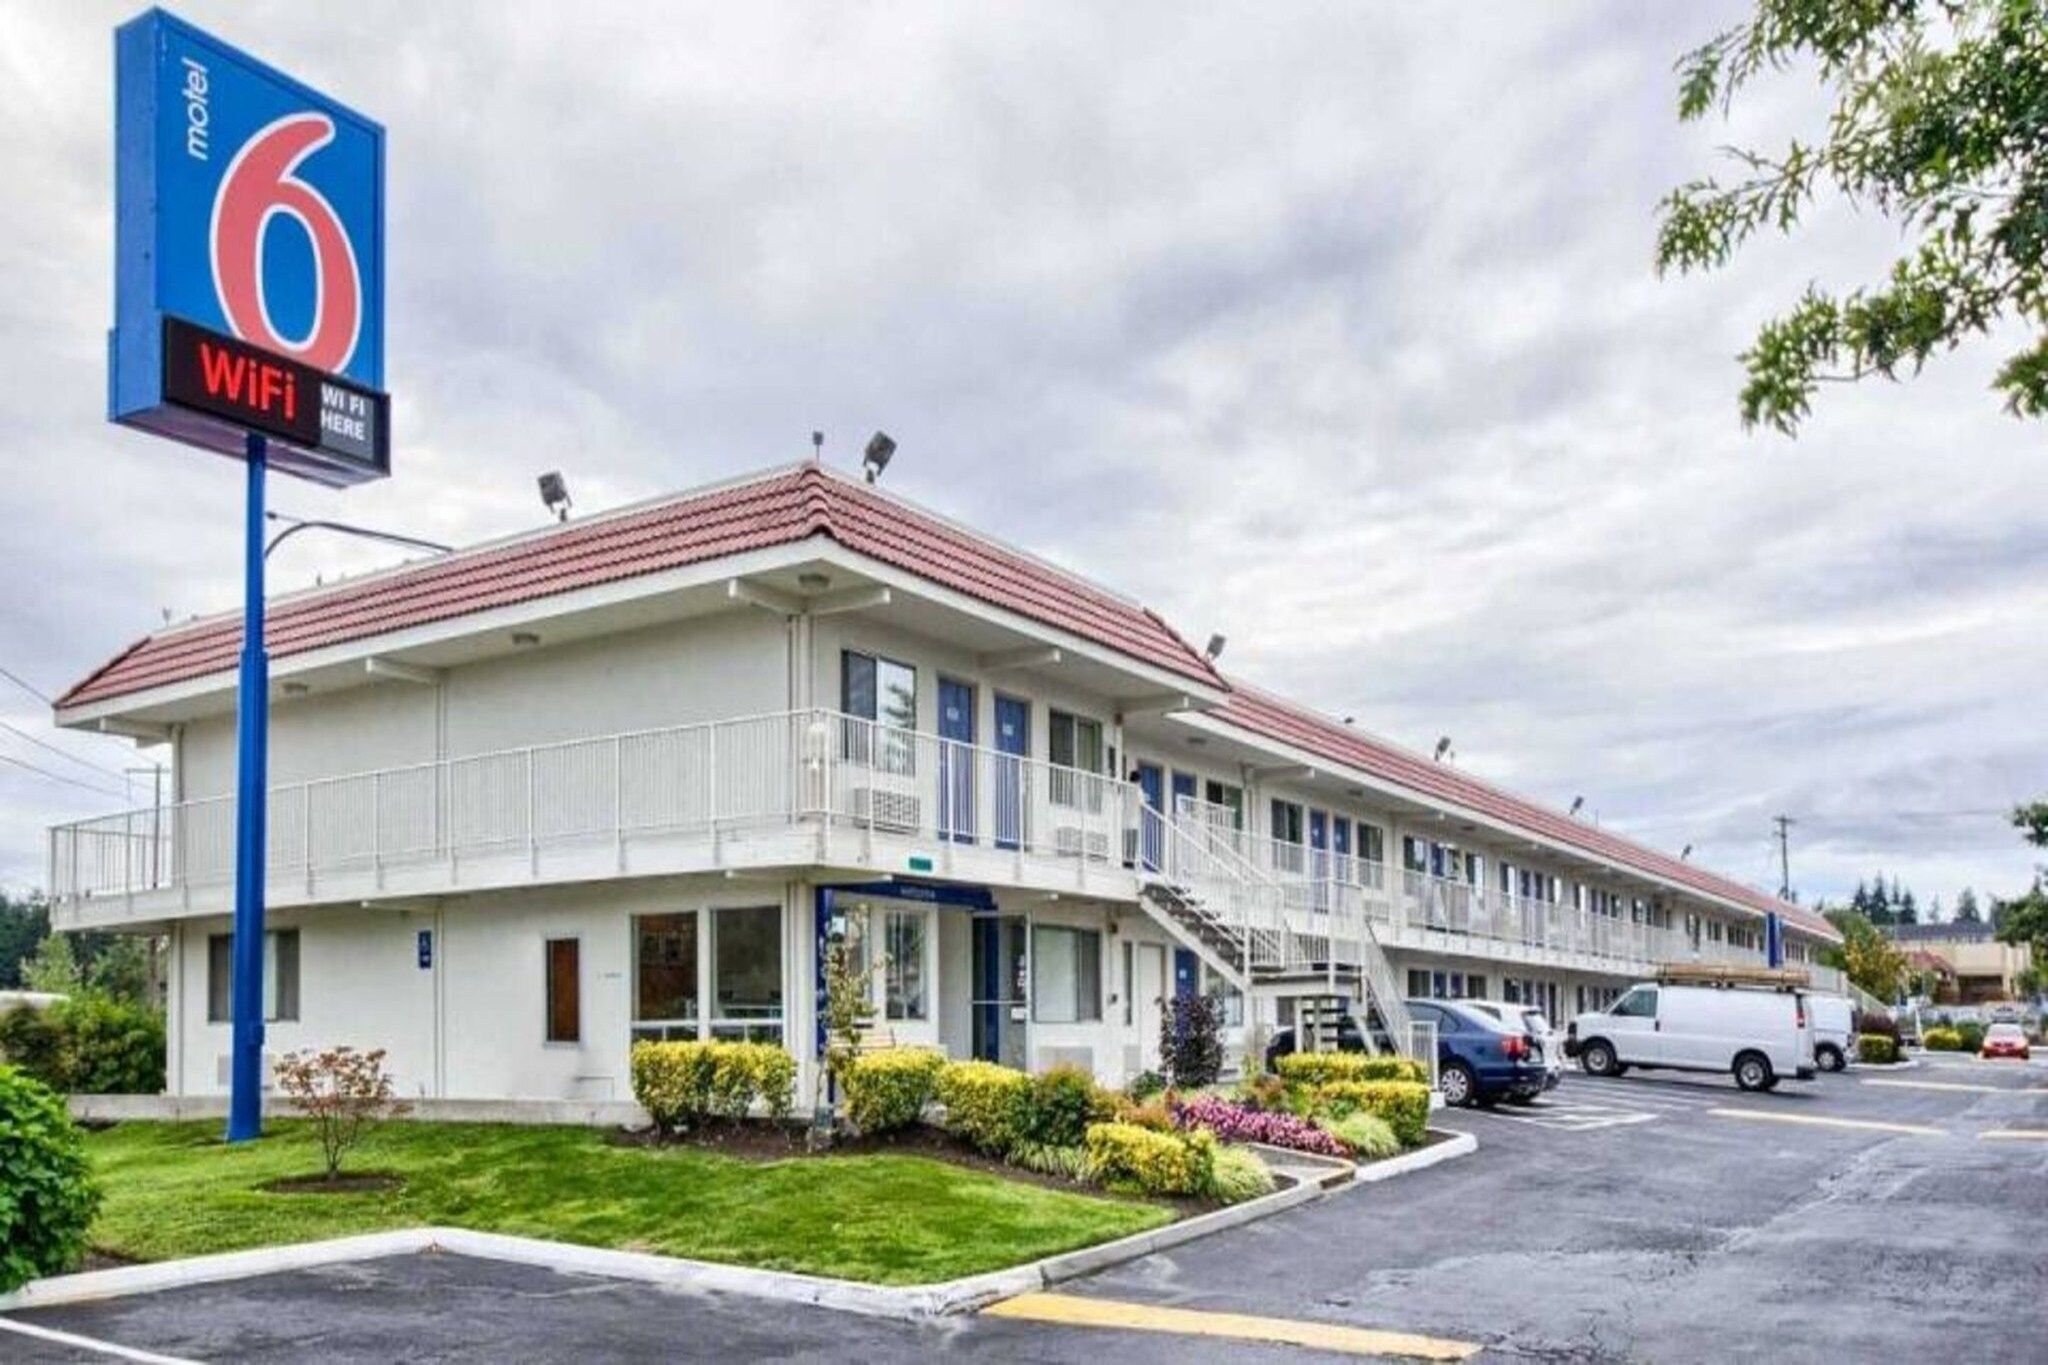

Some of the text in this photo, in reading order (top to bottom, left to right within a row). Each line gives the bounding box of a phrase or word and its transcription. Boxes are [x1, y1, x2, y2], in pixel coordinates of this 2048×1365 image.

[181, 57, 208, 161] motel
[211, 112, 361, 373] 6
[201, 342, 296, 421] WiFi
[321, 383, 364, 417] WI FI
[321, 408, 365, 440] HERE
